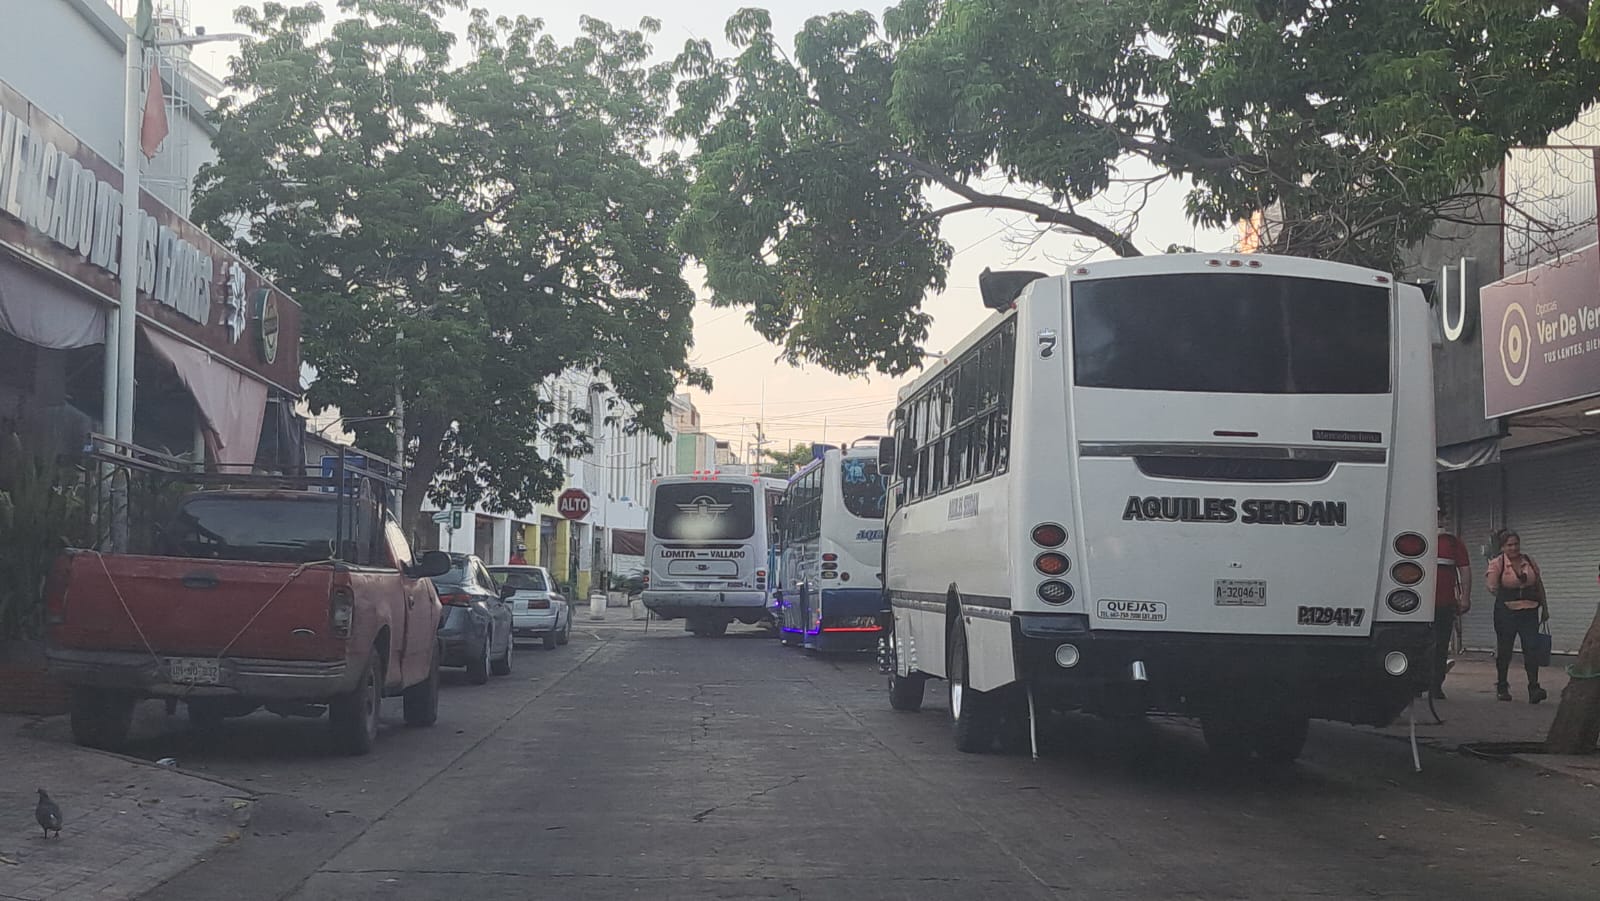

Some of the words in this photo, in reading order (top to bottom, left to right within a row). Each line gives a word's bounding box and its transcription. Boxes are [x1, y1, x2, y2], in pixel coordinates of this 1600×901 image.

[1536, 319, 1558, 345] Ver
[1560, 312, 1577, 338] De
[1038, 335, 1057, 360] 7
[1543, 350, 1557, 364] TUS
[561, 499, 588, 513] ALTO
[1122, 496, 1237, 523] AQUILES
[1240, 499, 1348, 526] SERDAN
[661, 550, 696, 558] LOMITA
[710, 550, 746, 559] VALLADO
[1216, 586, 1265, 599] A-32046-U
[1107, 601, 1157, 613] QUEJAS
